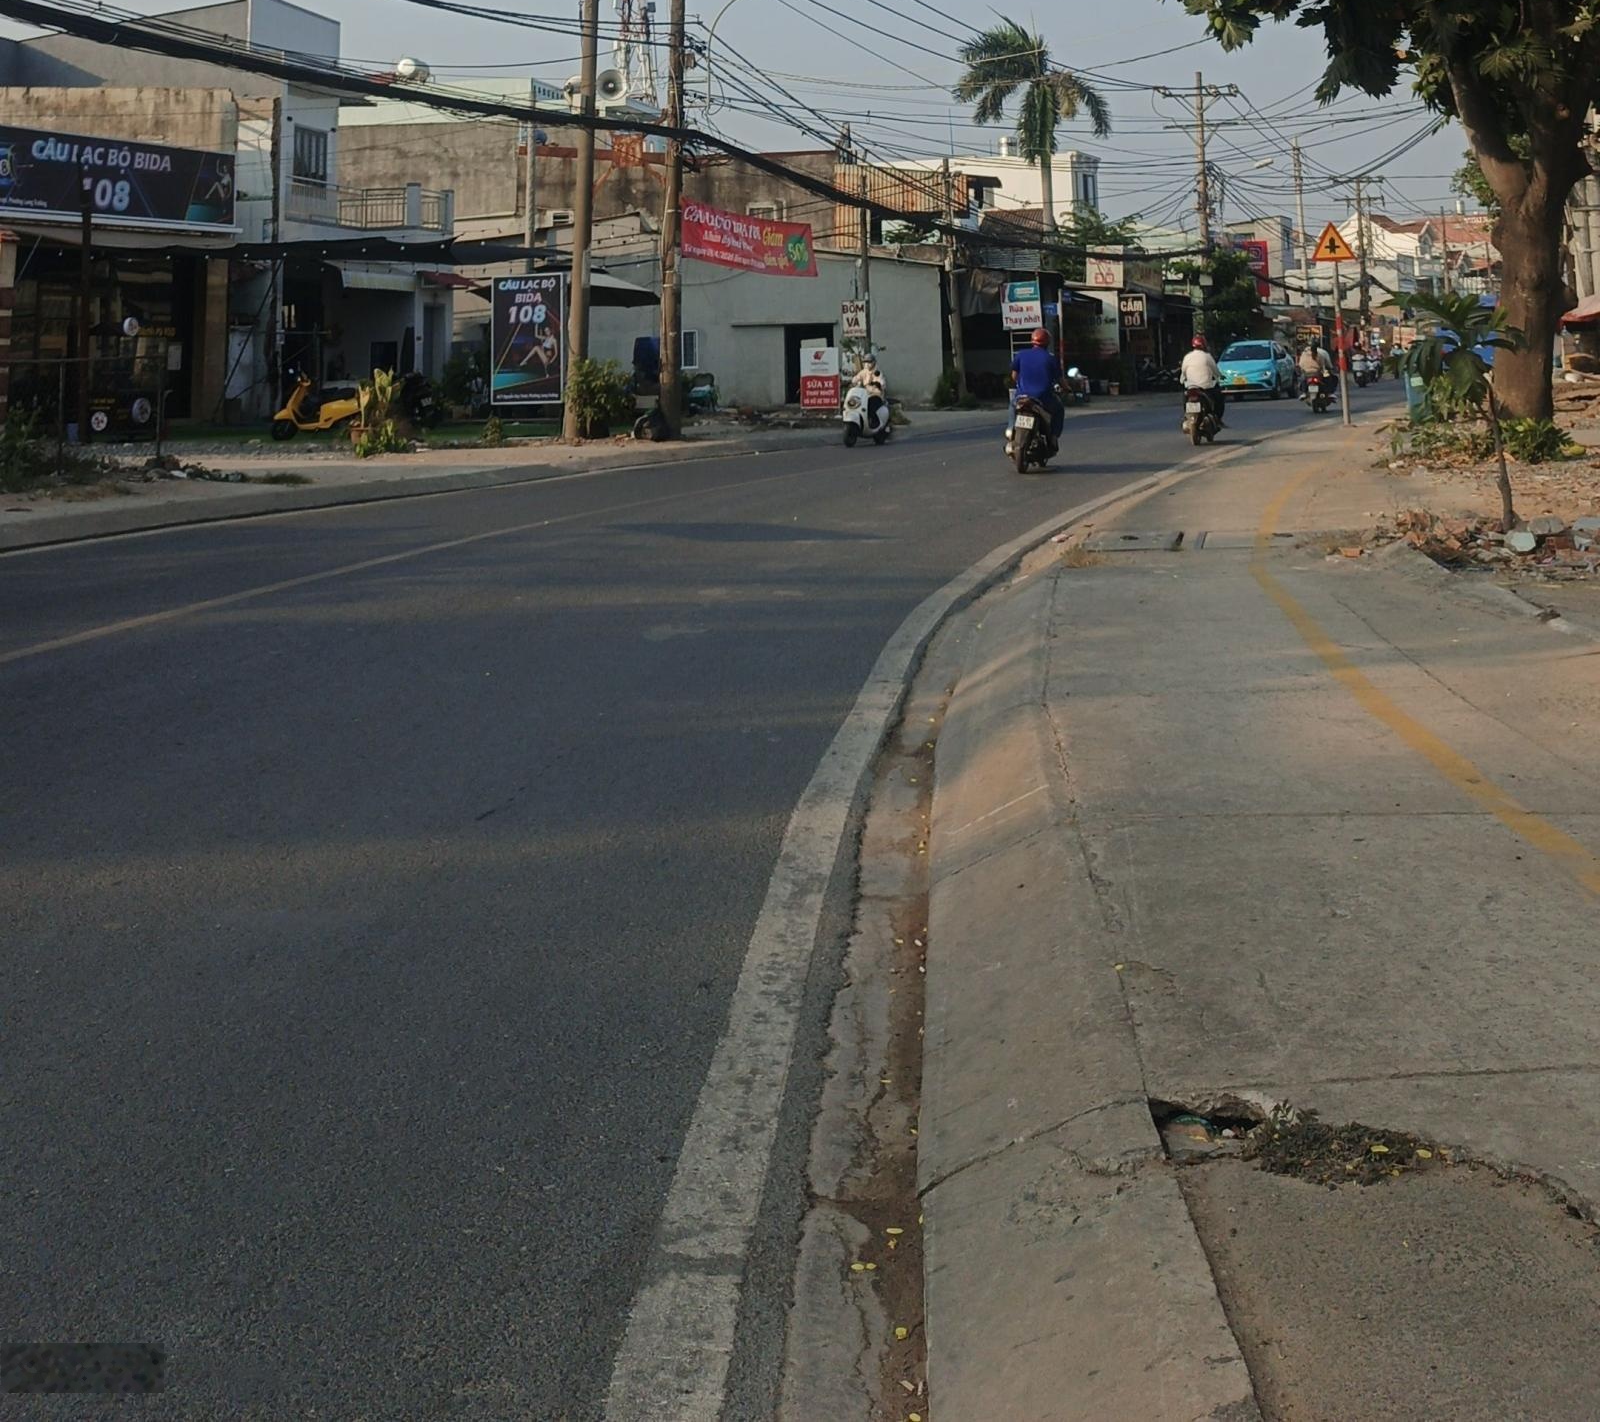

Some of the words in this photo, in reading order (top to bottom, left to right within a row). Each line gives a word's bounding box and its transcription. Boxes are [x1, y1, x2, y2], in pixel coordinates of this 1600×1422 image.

[32, 137, 70, 163] CÂU
[107, 146, 131, 174] BỘ
[134, 152, 172, 172] BIDA
[498, 279, 520, 290] CÂU
[521, 280, 540, 292] LẠC
[541, 277, 556, 292] BỘ
[515, 292, 542, 304] BIDA
[508, 304, 547, 324] 108
